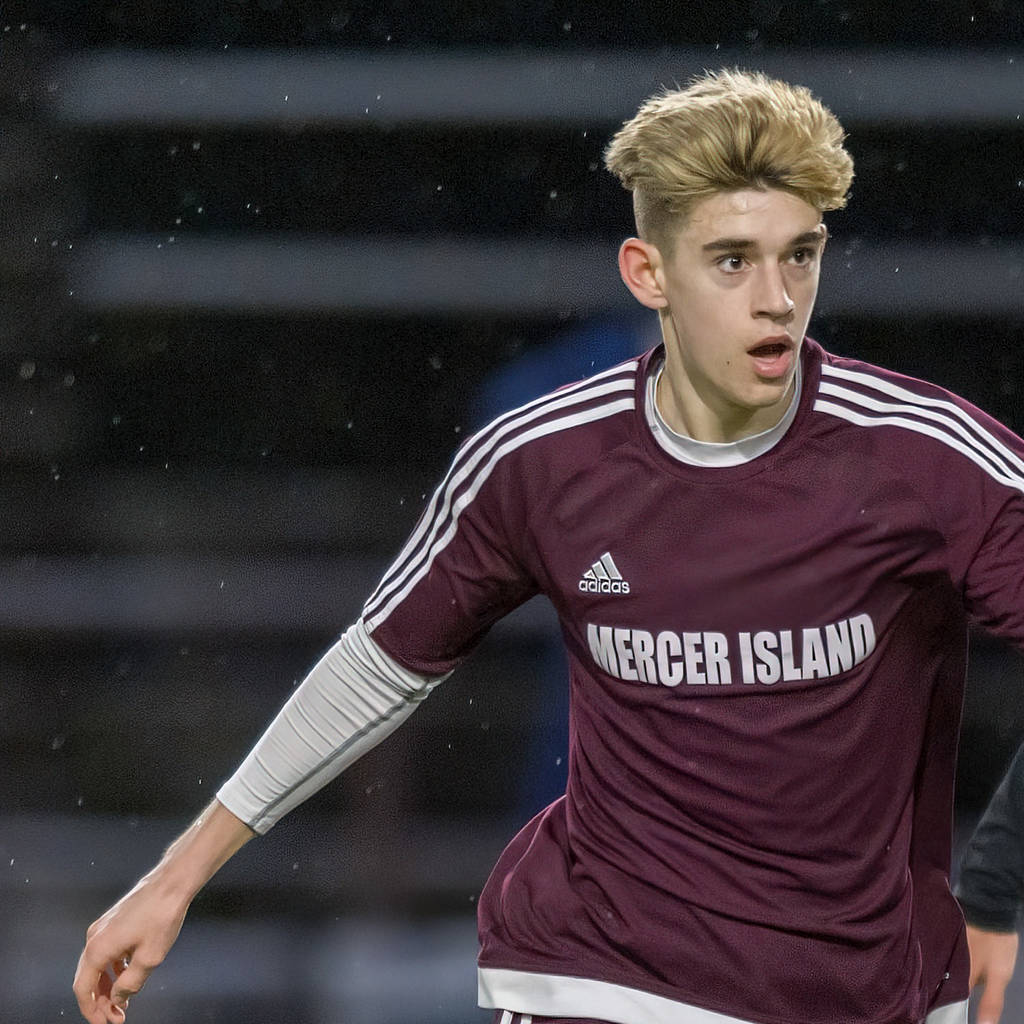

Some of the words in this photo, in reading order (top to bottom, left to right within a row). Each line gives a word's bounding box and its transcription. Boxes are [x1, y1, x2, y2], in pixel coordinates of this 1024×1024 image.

[578, 577, 630, 594] adidas
[587, 623, 732, 687] MERCER
[738, 613, 876, 685] ISLAND
